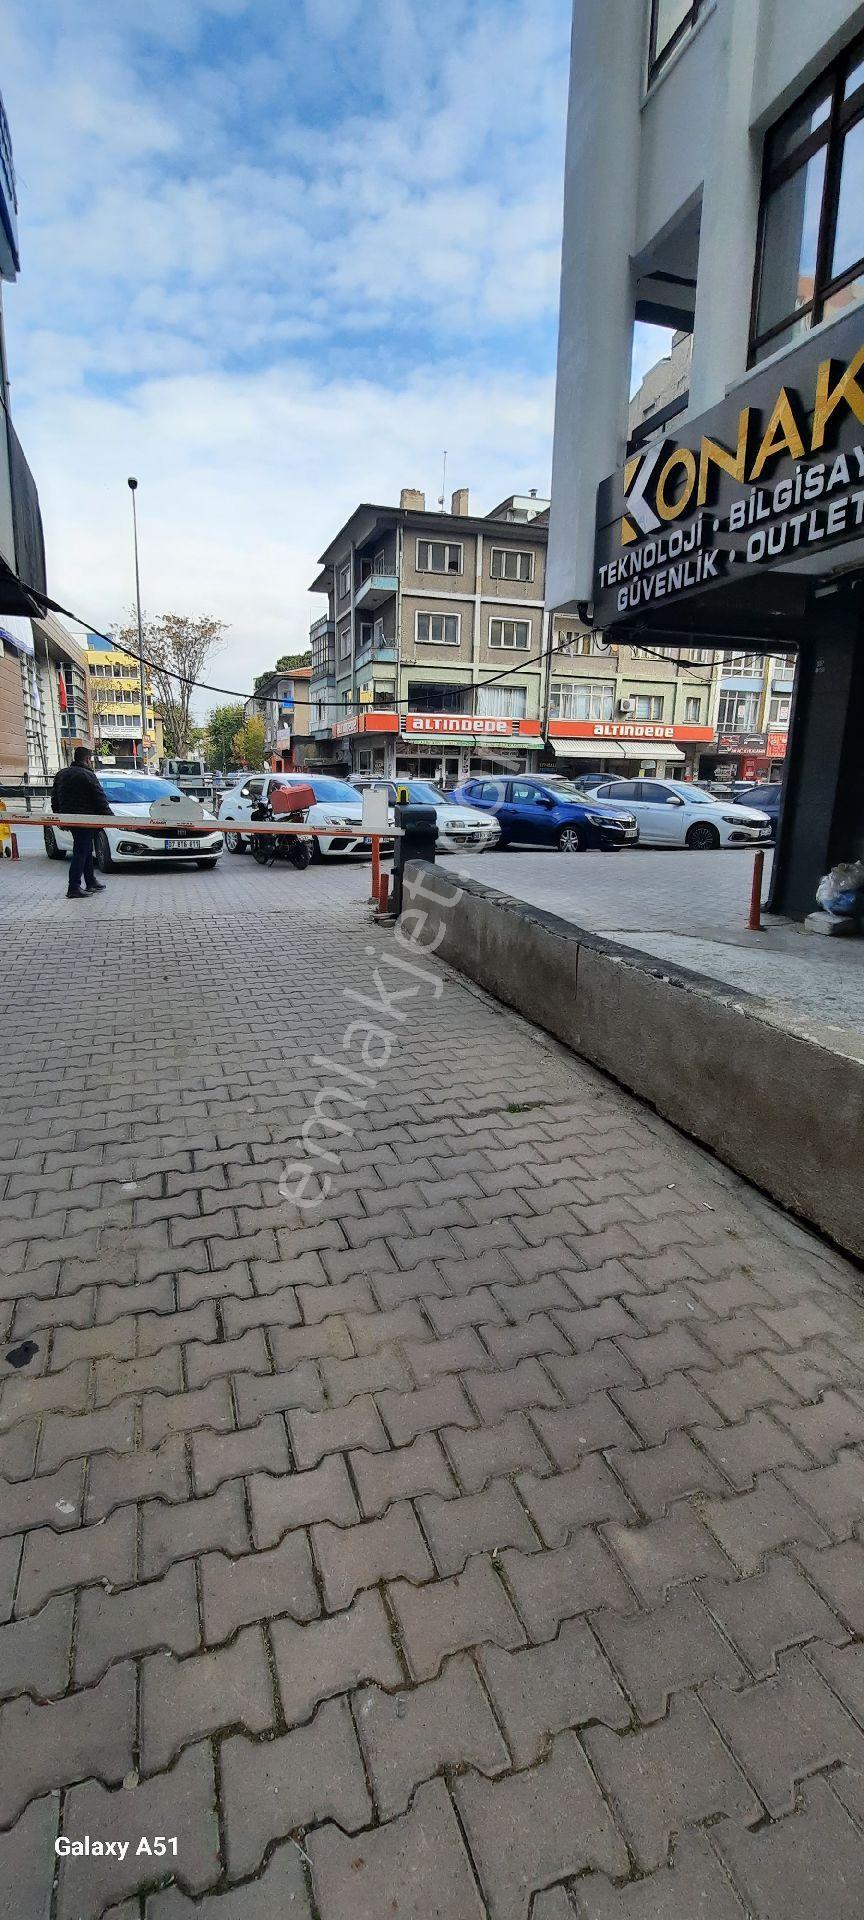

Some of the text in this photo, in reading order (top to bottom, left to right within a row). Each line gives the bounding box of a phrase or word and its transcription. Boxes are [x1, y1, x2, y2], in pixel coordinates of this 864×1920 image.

[621, 344, 864, 546] KONAK
[599, 512, 702, 588] TEKNOLOJİ
[617, 490, 864, 612] GÜVENLİK OUTLET
